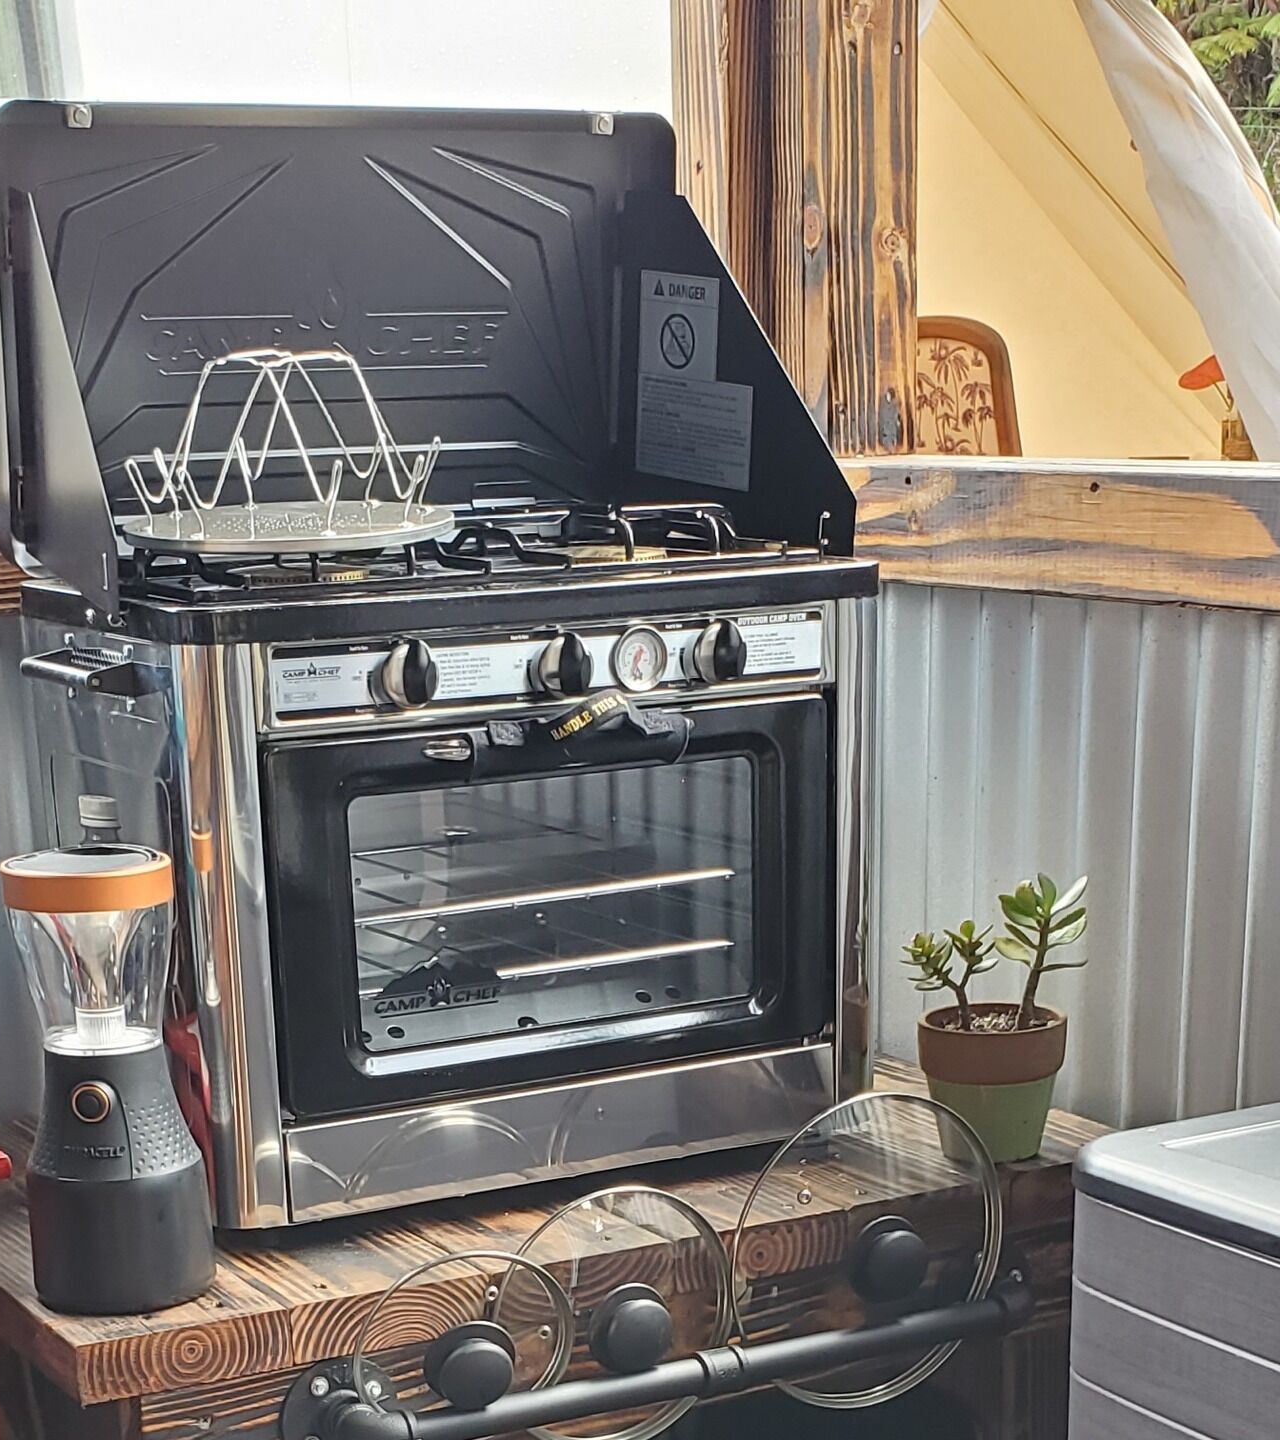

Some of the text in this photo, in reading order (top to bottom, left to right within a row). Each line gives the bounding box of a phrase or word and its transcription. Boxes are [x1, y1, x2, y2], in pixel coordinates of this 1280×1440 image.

[668, 282, 706, 301] DANGER
[367, 321, 501, 357] CHEF
[769, 613, 788, 623] CAMP
[282, 667, 341, 679] CAMP CHEF
[550, 710, 593, 741] HANDLE
[591, 697, 618, 717] THIS
[374, 985, 502, 1015] CAMP CHEF
